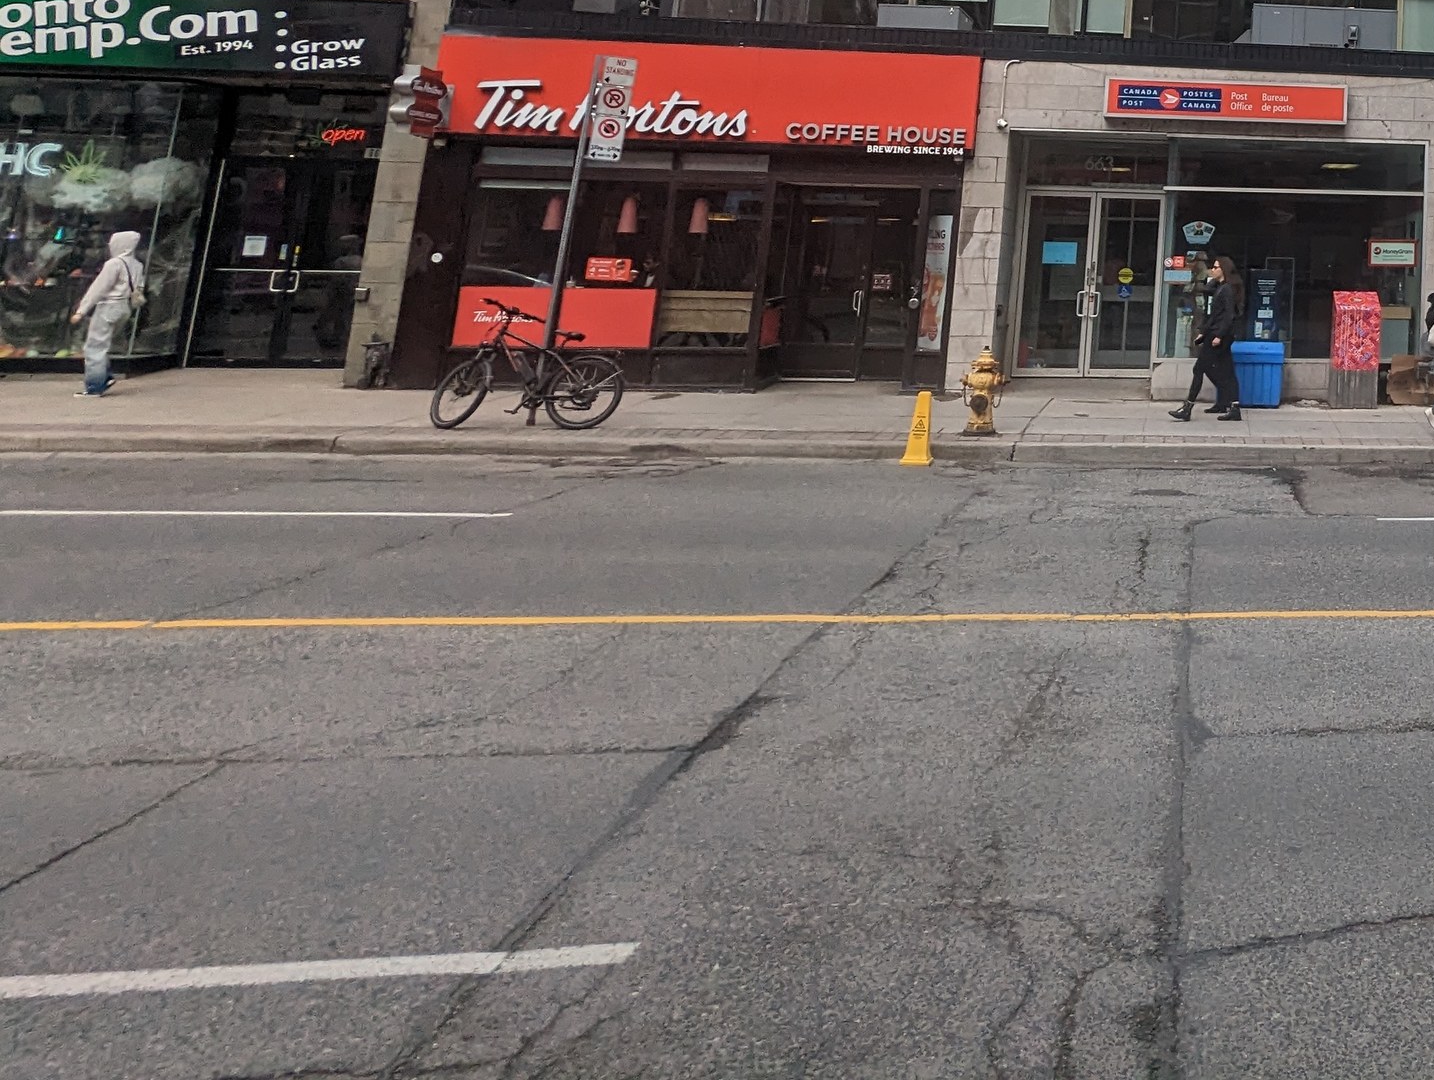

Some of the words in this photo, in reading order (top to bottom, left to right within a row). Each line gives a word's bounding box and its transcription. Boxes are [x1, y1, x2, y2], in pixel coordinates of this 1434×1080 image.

[0, 5, 258, 58] emp.Com
[181, 45, 212, 56] Est.
[214, 40, 254, 53] 1994
[291, 38, 365, 54] Grow
[291, 55, 361, 71] Glass
[616, 59, 627, 67] NO
[1123, 88, 1158, 96] CANADA
[1183, 90, 1214, 98] POSTES
[1231, 91, 1248, 101] Post
[1262, 93, 1289, 102] Bureau
[474, 79, 565, 131] Tim
[1122, 99, 1143, 107] POST
[1182, 101, 1217, 109] CANADA
[1230, 102, 1253, 111] Office
[1261, 103, 1272, 112] de
[1272, 104, 1294, 113] poste
[321, 128, 366, 146] open
[785, 122, 880, 142] COFFEE
[887, 125, 967, 145] HOUSE
[866, 145, 911, 154] BREWING
[912, 146, 941, 155] SINCE
[942, 147, 964, 155] 1964
[1085, 155, 1114, 170] 663
[474, 310, 492, 323] Tim
